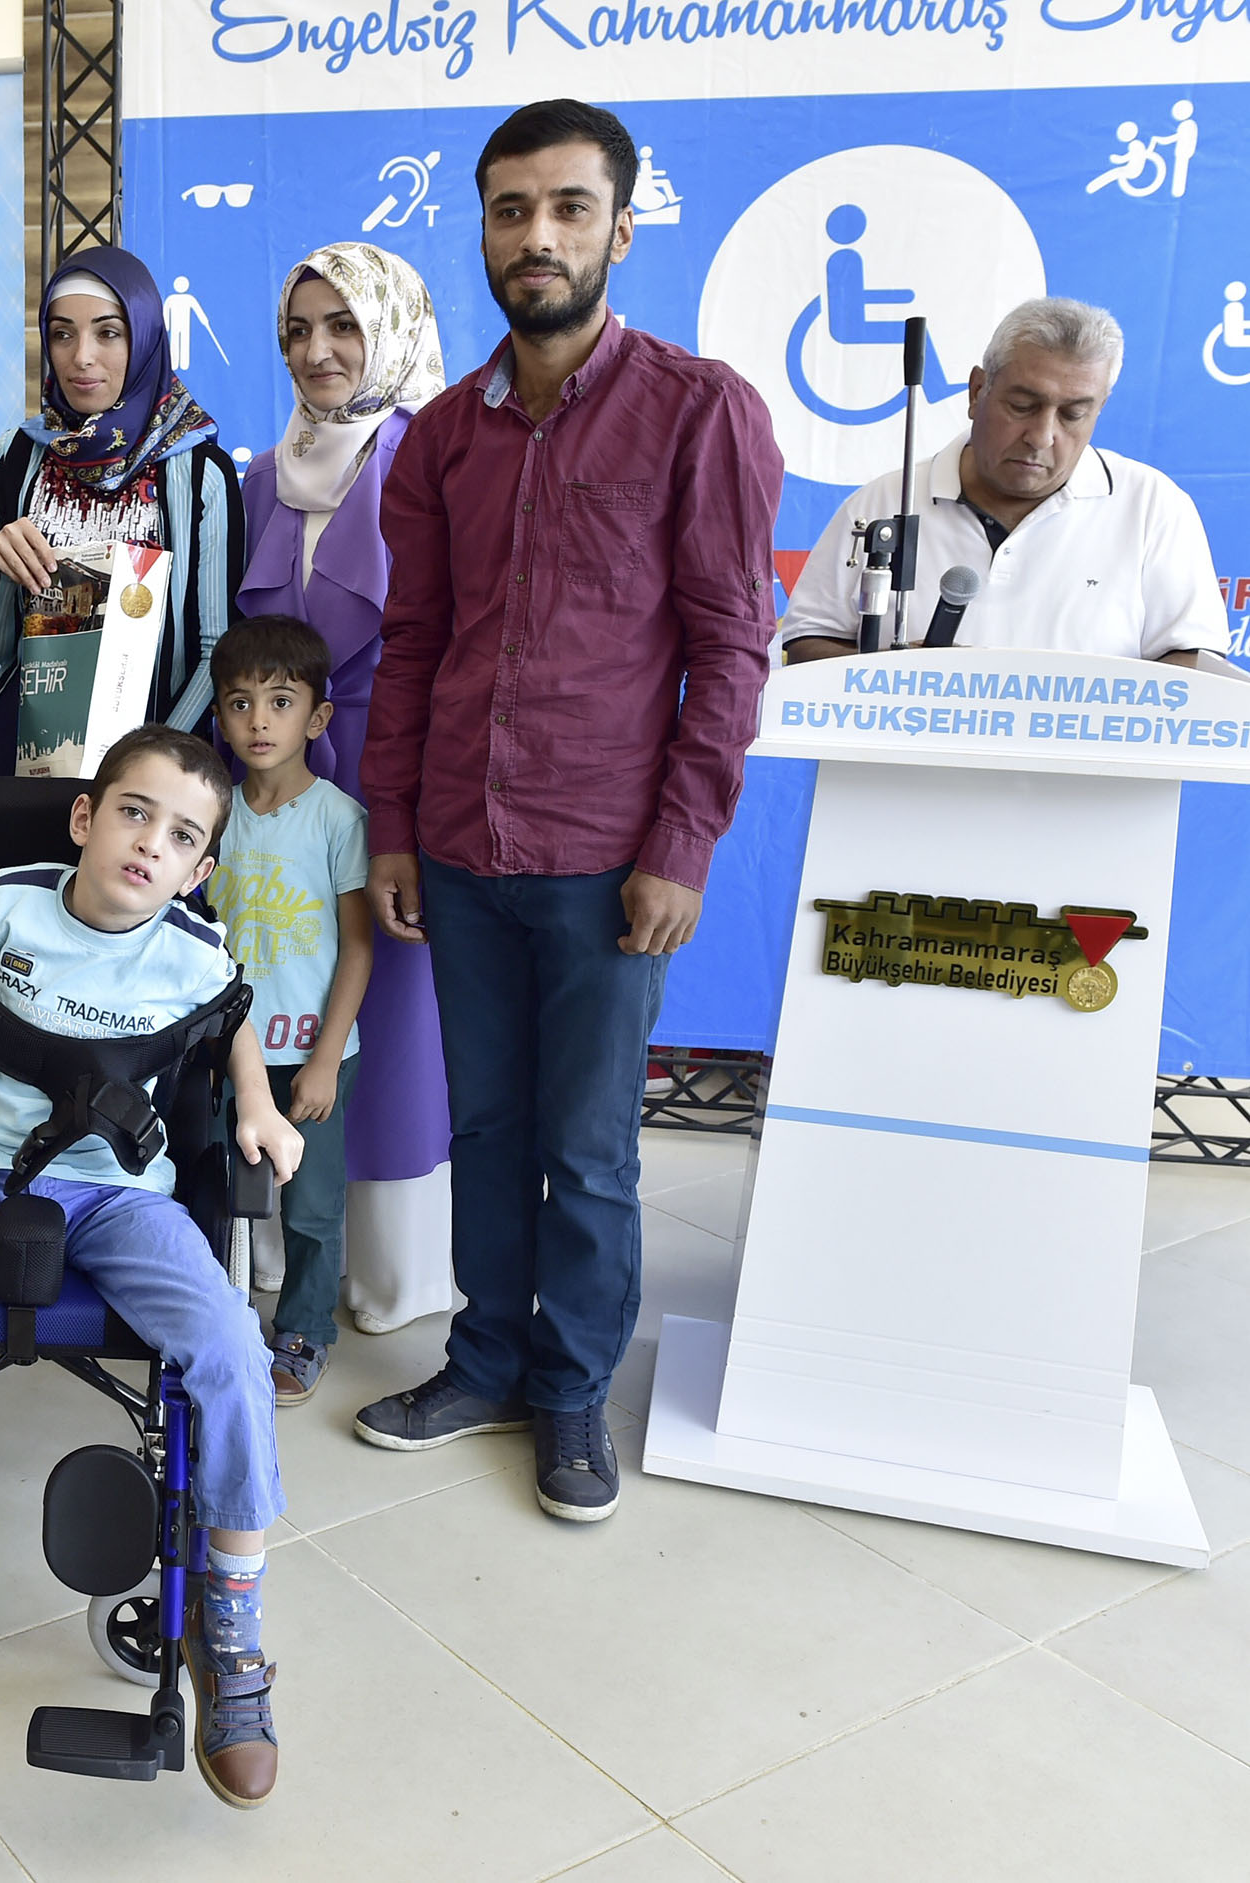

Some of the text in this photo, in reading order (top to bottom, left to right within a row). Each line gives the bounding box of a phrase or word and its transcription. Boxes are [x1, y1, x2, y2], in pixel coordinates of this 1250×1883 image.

[210, 0, 477, 80] Engelsiz
[844, 668, 1189, 711] KAHRAMANMARAŞ
[832, 923, 1062, 971] Kahramanmaraş
[826, 950, 1059, 996] Büyükşehir Belediyesi
[57, 995, 156, 1032] TRADEMARK
[264, 1013, 320, 1050] 08
